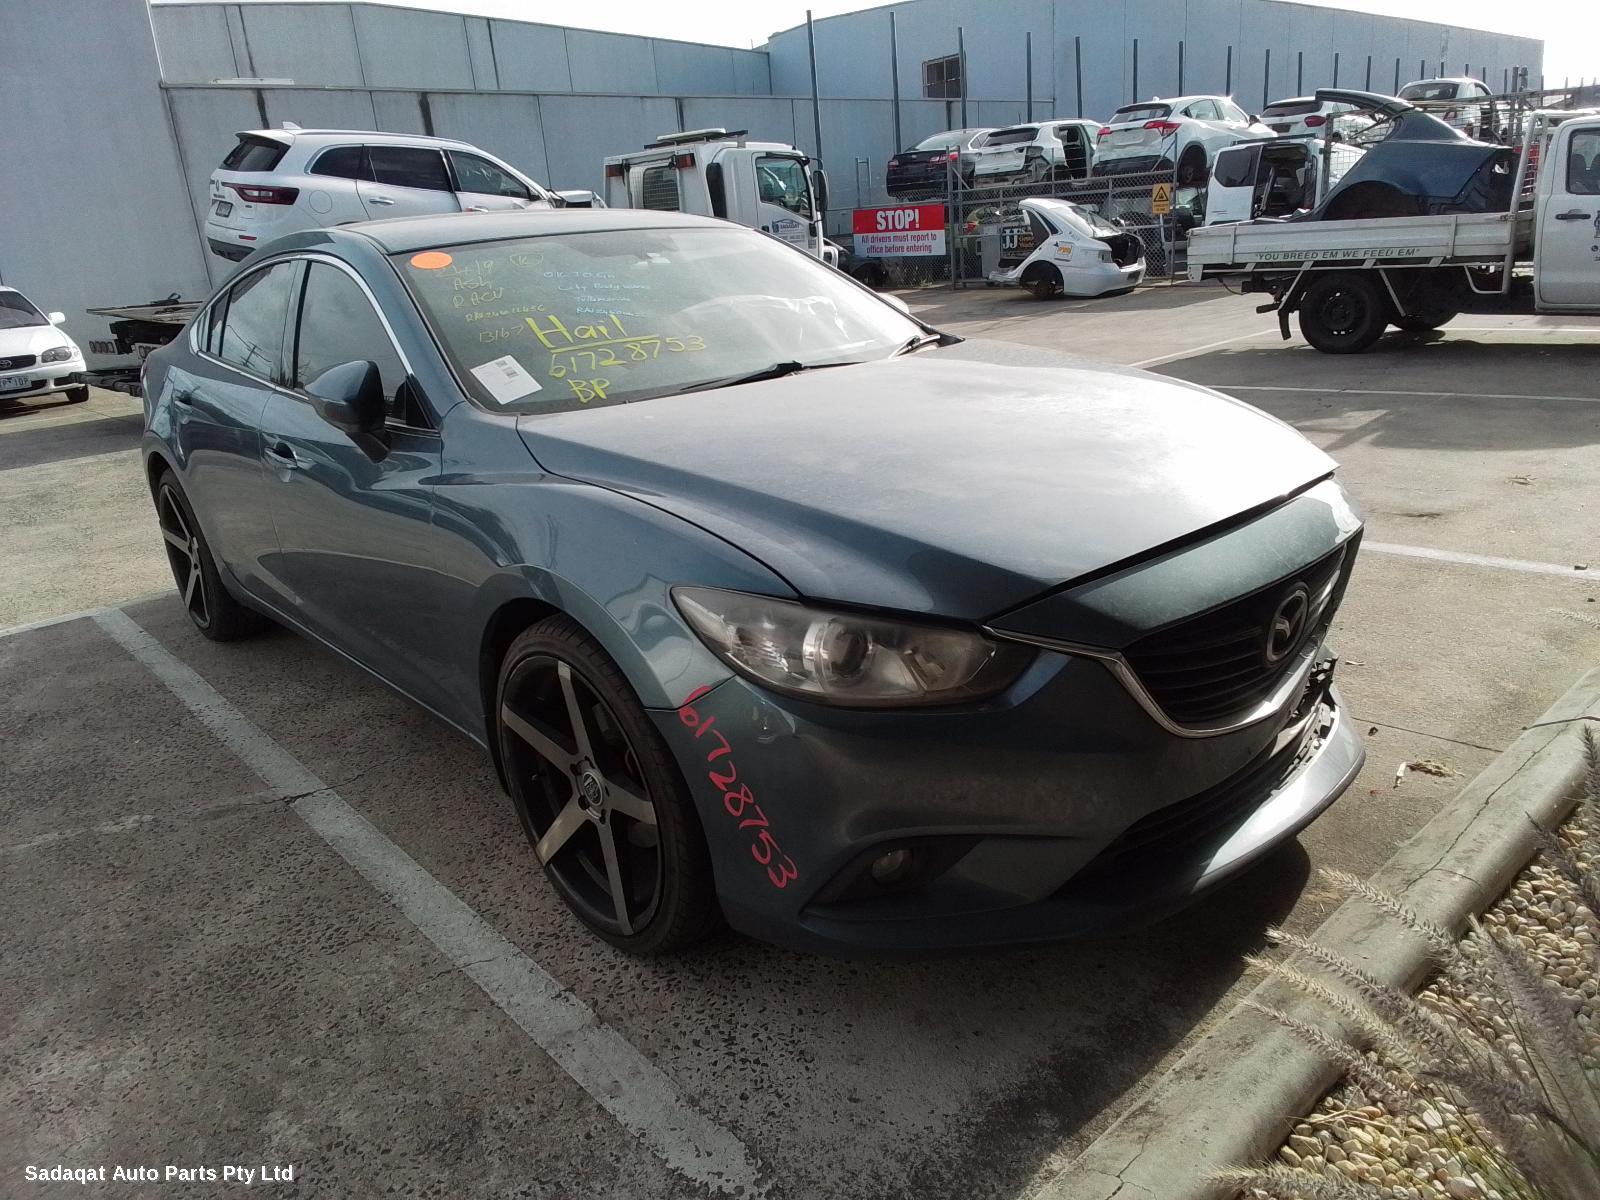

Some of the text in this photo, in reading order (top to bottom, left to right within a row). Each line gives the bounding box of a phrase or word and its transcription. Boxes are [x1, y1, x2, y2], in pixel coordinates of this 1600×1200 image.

[876, 208, 919, 231] STOP!
[861, 232, 937, 243] All drivers must report to
[866, 243, 932, 254] office before entering
[1283, 251, 1318, 260] BREED
[1342, 250, 1359, 258] WE
[1363, 249, 1393, 258] FEED
[525, 314, 629, 348] Hail
[549, 334, 707, 378] 61728753
[567, 377, 611, 403] BP
[679, 685, 798, 888] 61728753
